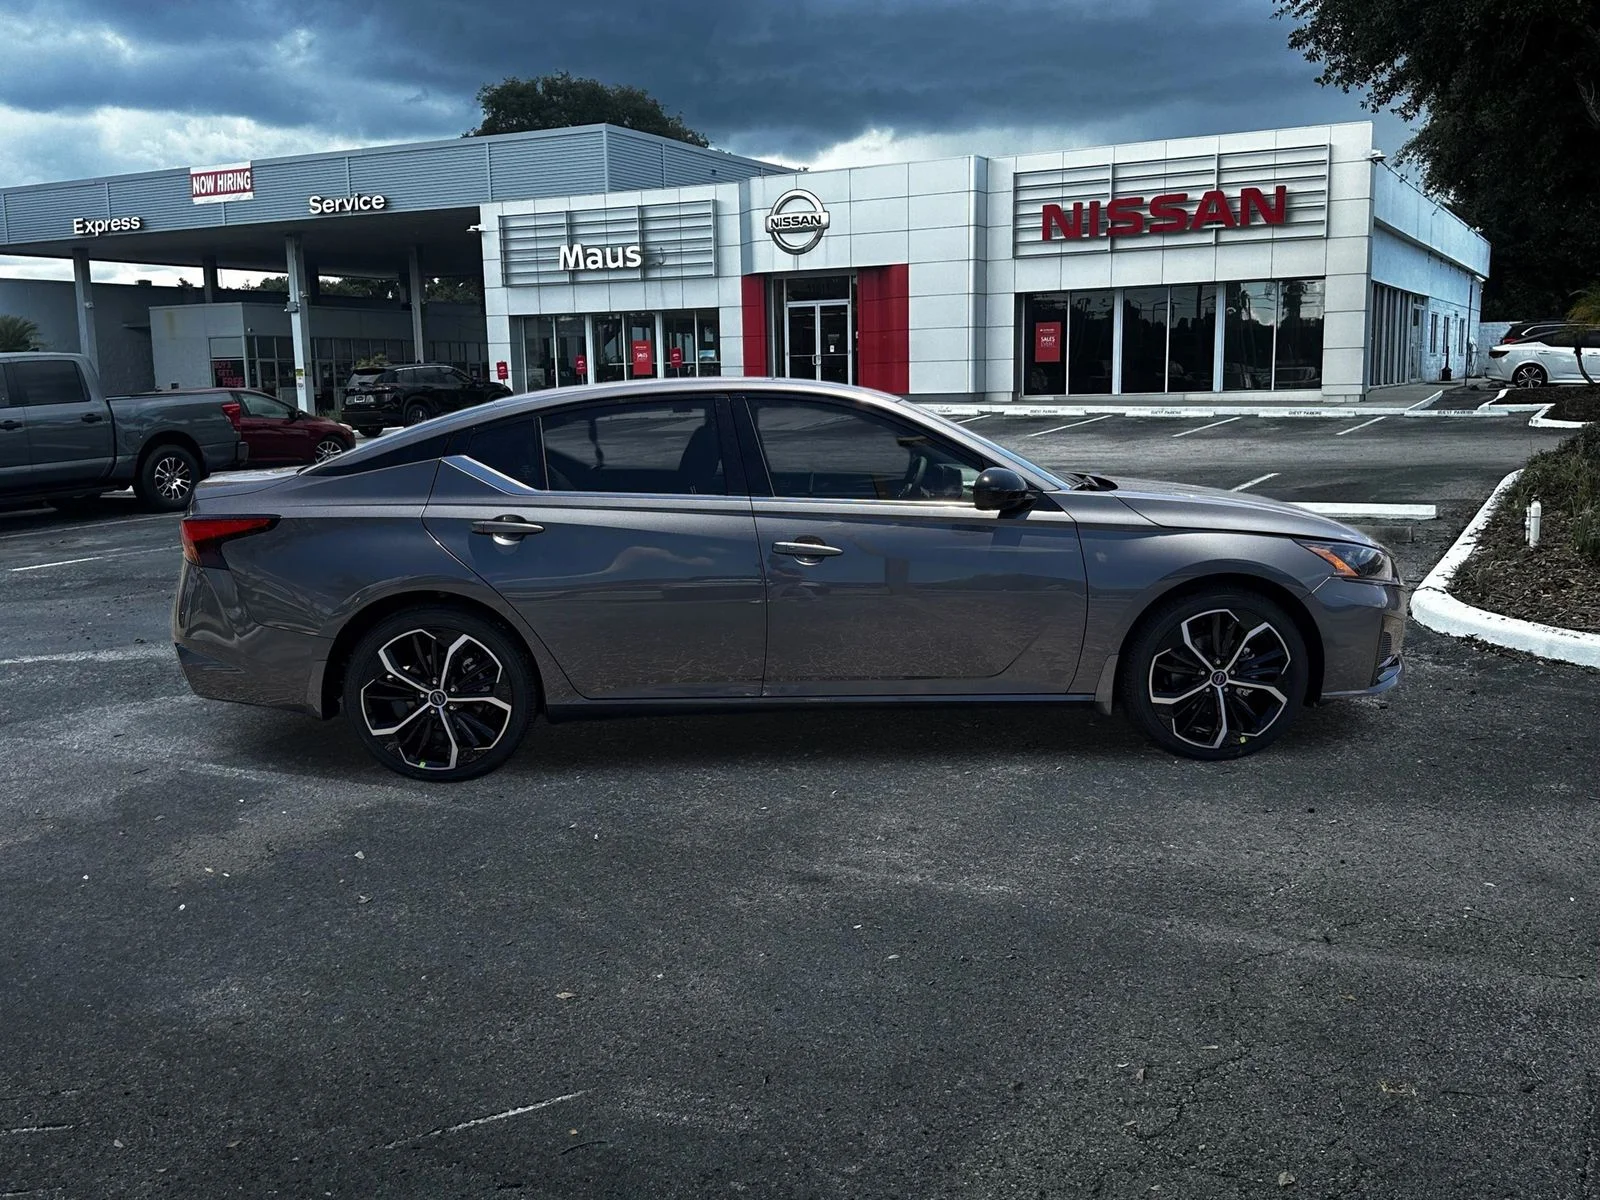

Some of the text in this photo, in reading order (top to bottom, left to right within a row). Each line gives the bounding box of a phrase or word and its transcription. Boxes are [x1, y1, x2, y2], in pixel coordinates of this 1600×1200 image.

[192, 171, 251, 195] NOW HIRING
[308, 193, 386, 214] Service
[1042, 185, 1287, 241] NISSAN
[73, 216, 141, 236] Express
[769, 214, 822, 229] NISSAN
[558, 243, 642, 271] Maus
[222, 376, 244, 387] FREE
